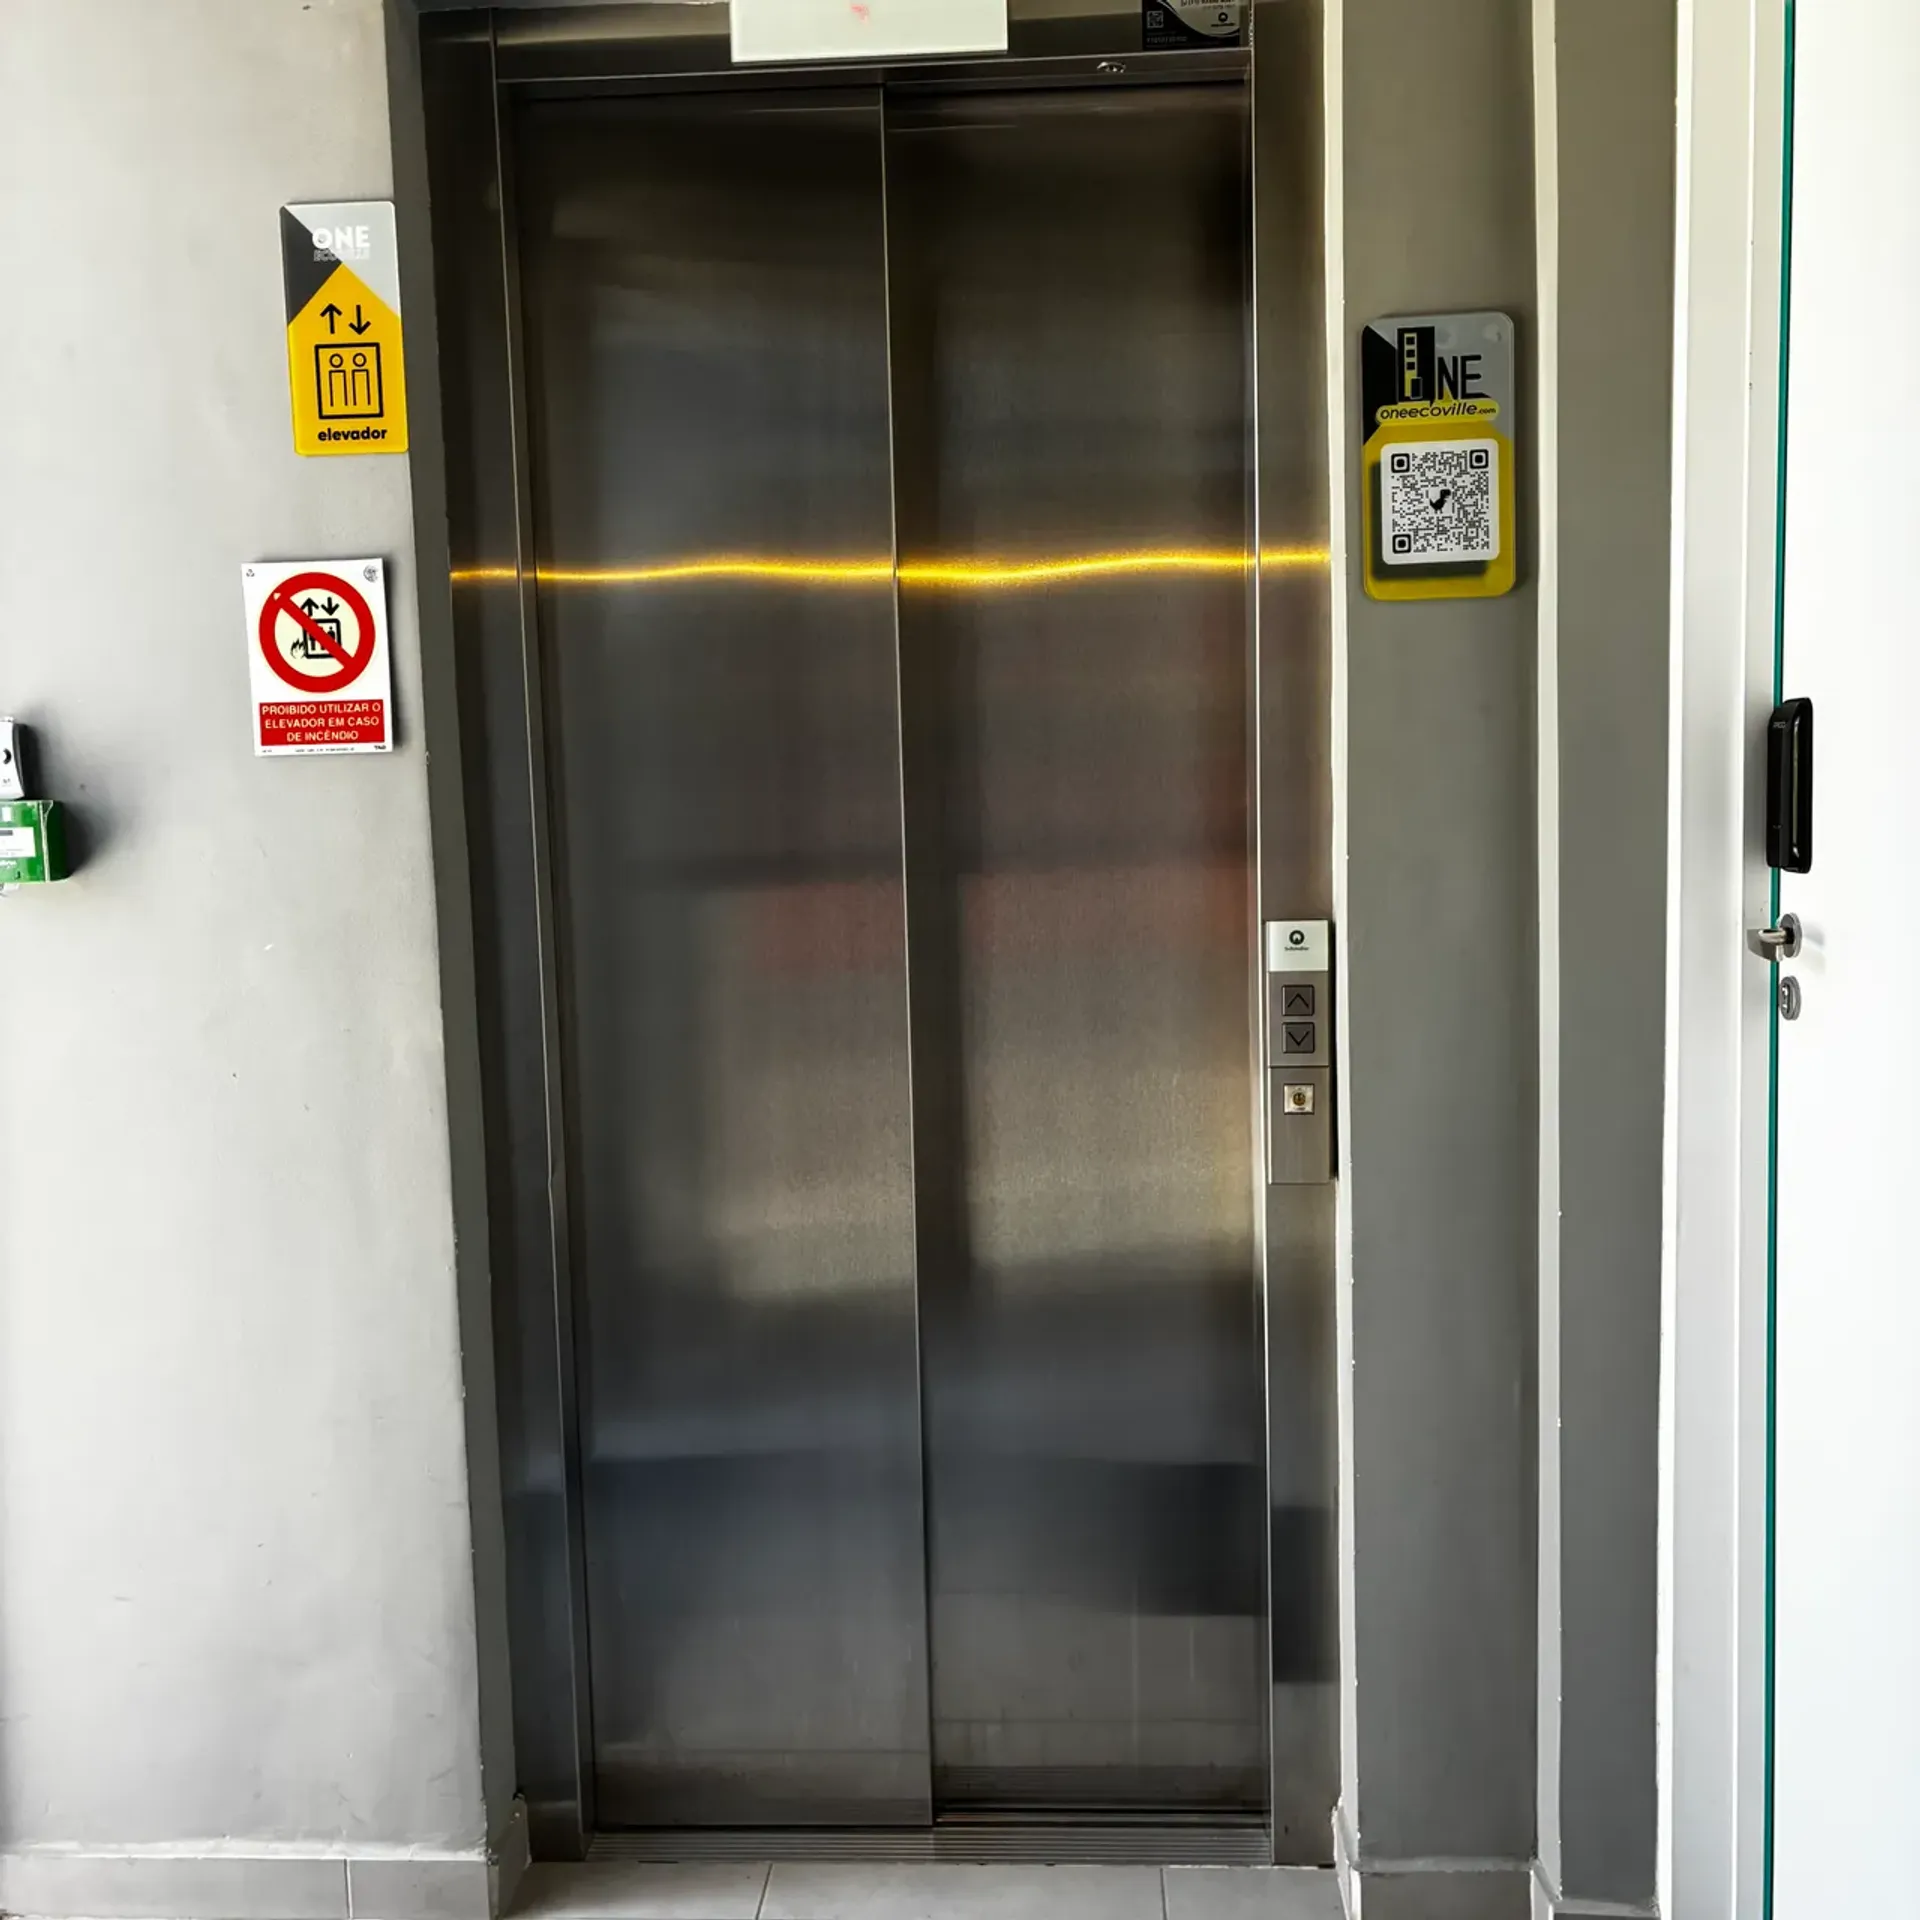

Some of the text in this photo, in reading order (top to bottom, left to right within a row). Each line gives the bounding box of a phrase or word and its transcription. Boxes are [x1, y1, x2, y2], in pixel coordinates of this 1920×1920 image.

[312, 226, 370, 249] ONE
[1380, 402, 1497, 419] oneecoville.com
[317, 427, 388, 442] elevador
[261, 702, 381, 715] PROIBIDO UTILIZAR O
[264, 716, 380, 729] ELEVADOR EM CASO
[286, 729, 359, 742] DE INCÊNDIO
